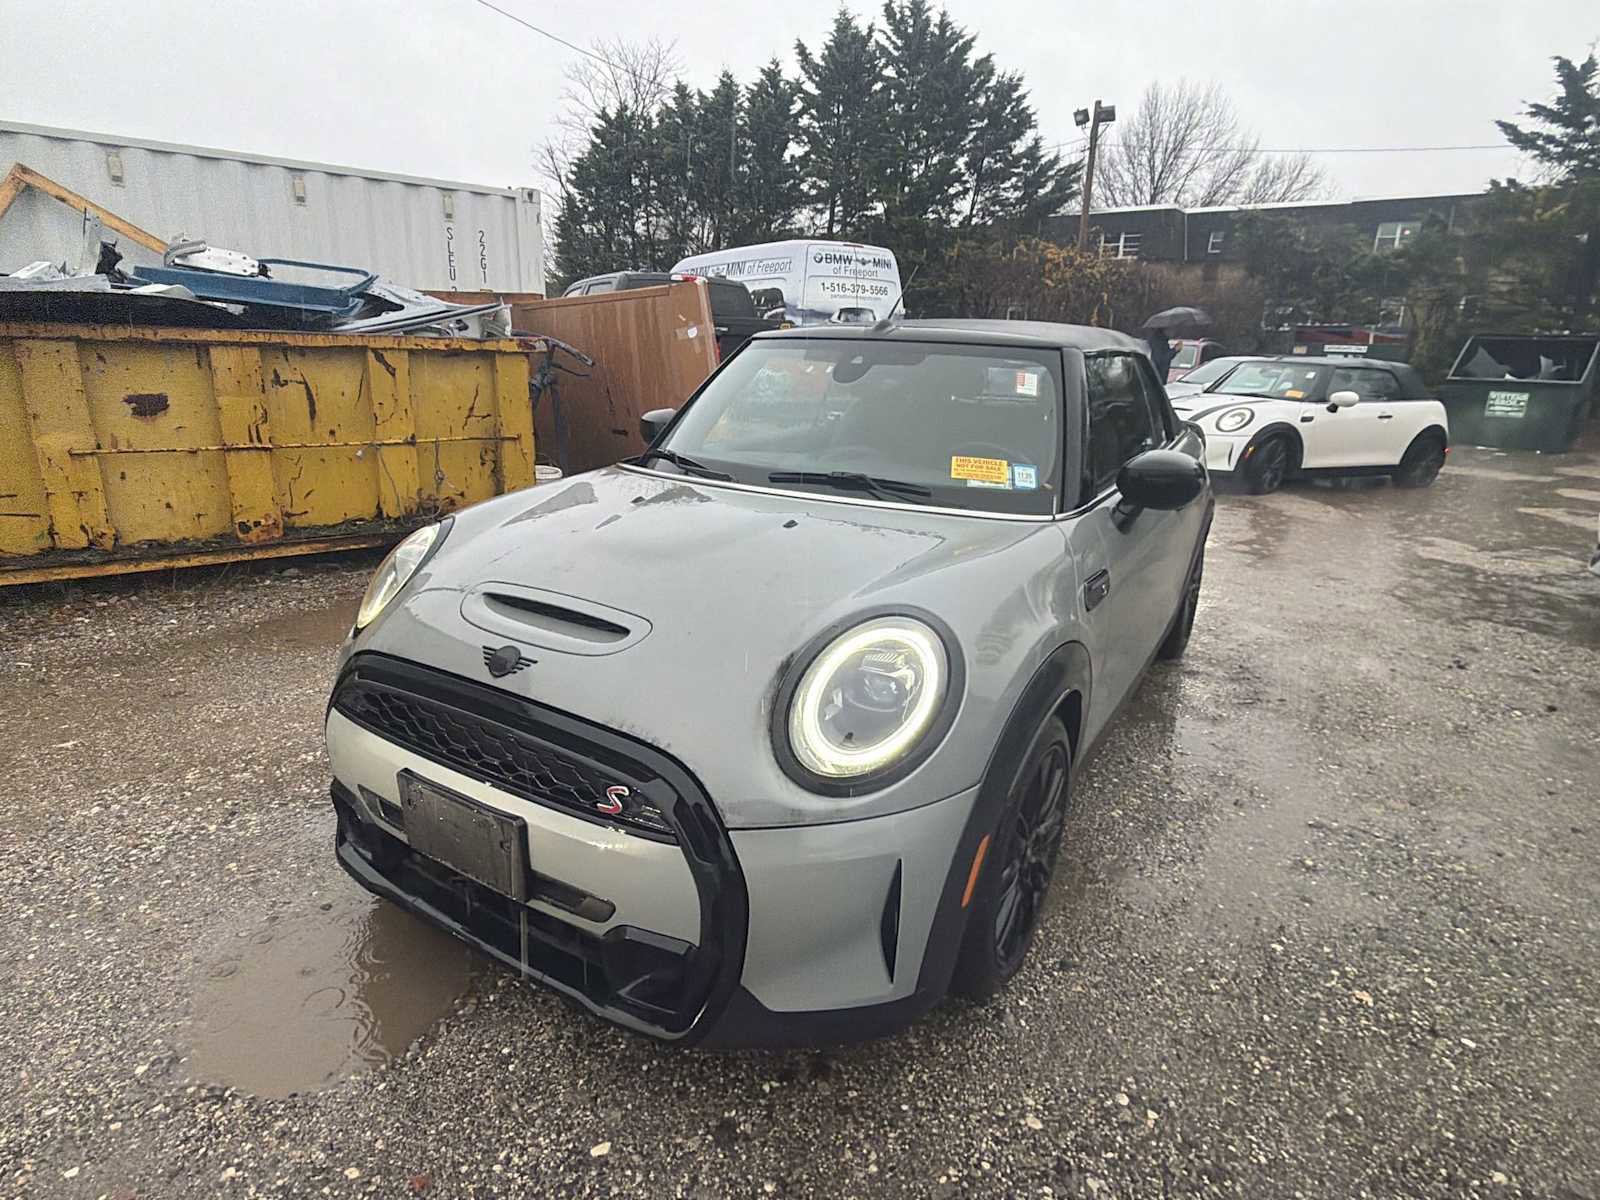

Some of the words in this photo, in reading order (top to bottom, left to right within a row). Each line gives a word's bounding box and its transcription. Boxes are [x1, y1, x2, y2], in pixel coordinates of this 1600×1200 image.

[446, 226, 456, 281] SLEU
[477, 230, 487, 284] 22G1
[824, 253, 853, 265] BMW
[873, 258, 892, 269] MINI
[725, 261, 747, 276] MINI
[747, 264, 755, 274] of
[757, 260, 792, 274] Freeport
[833, 266, 841, 275] of
[844, 266, 878, 278] Freeport
[973, 458, 1003, 466] VEHICLE
[596, 785, 630, 815] S
